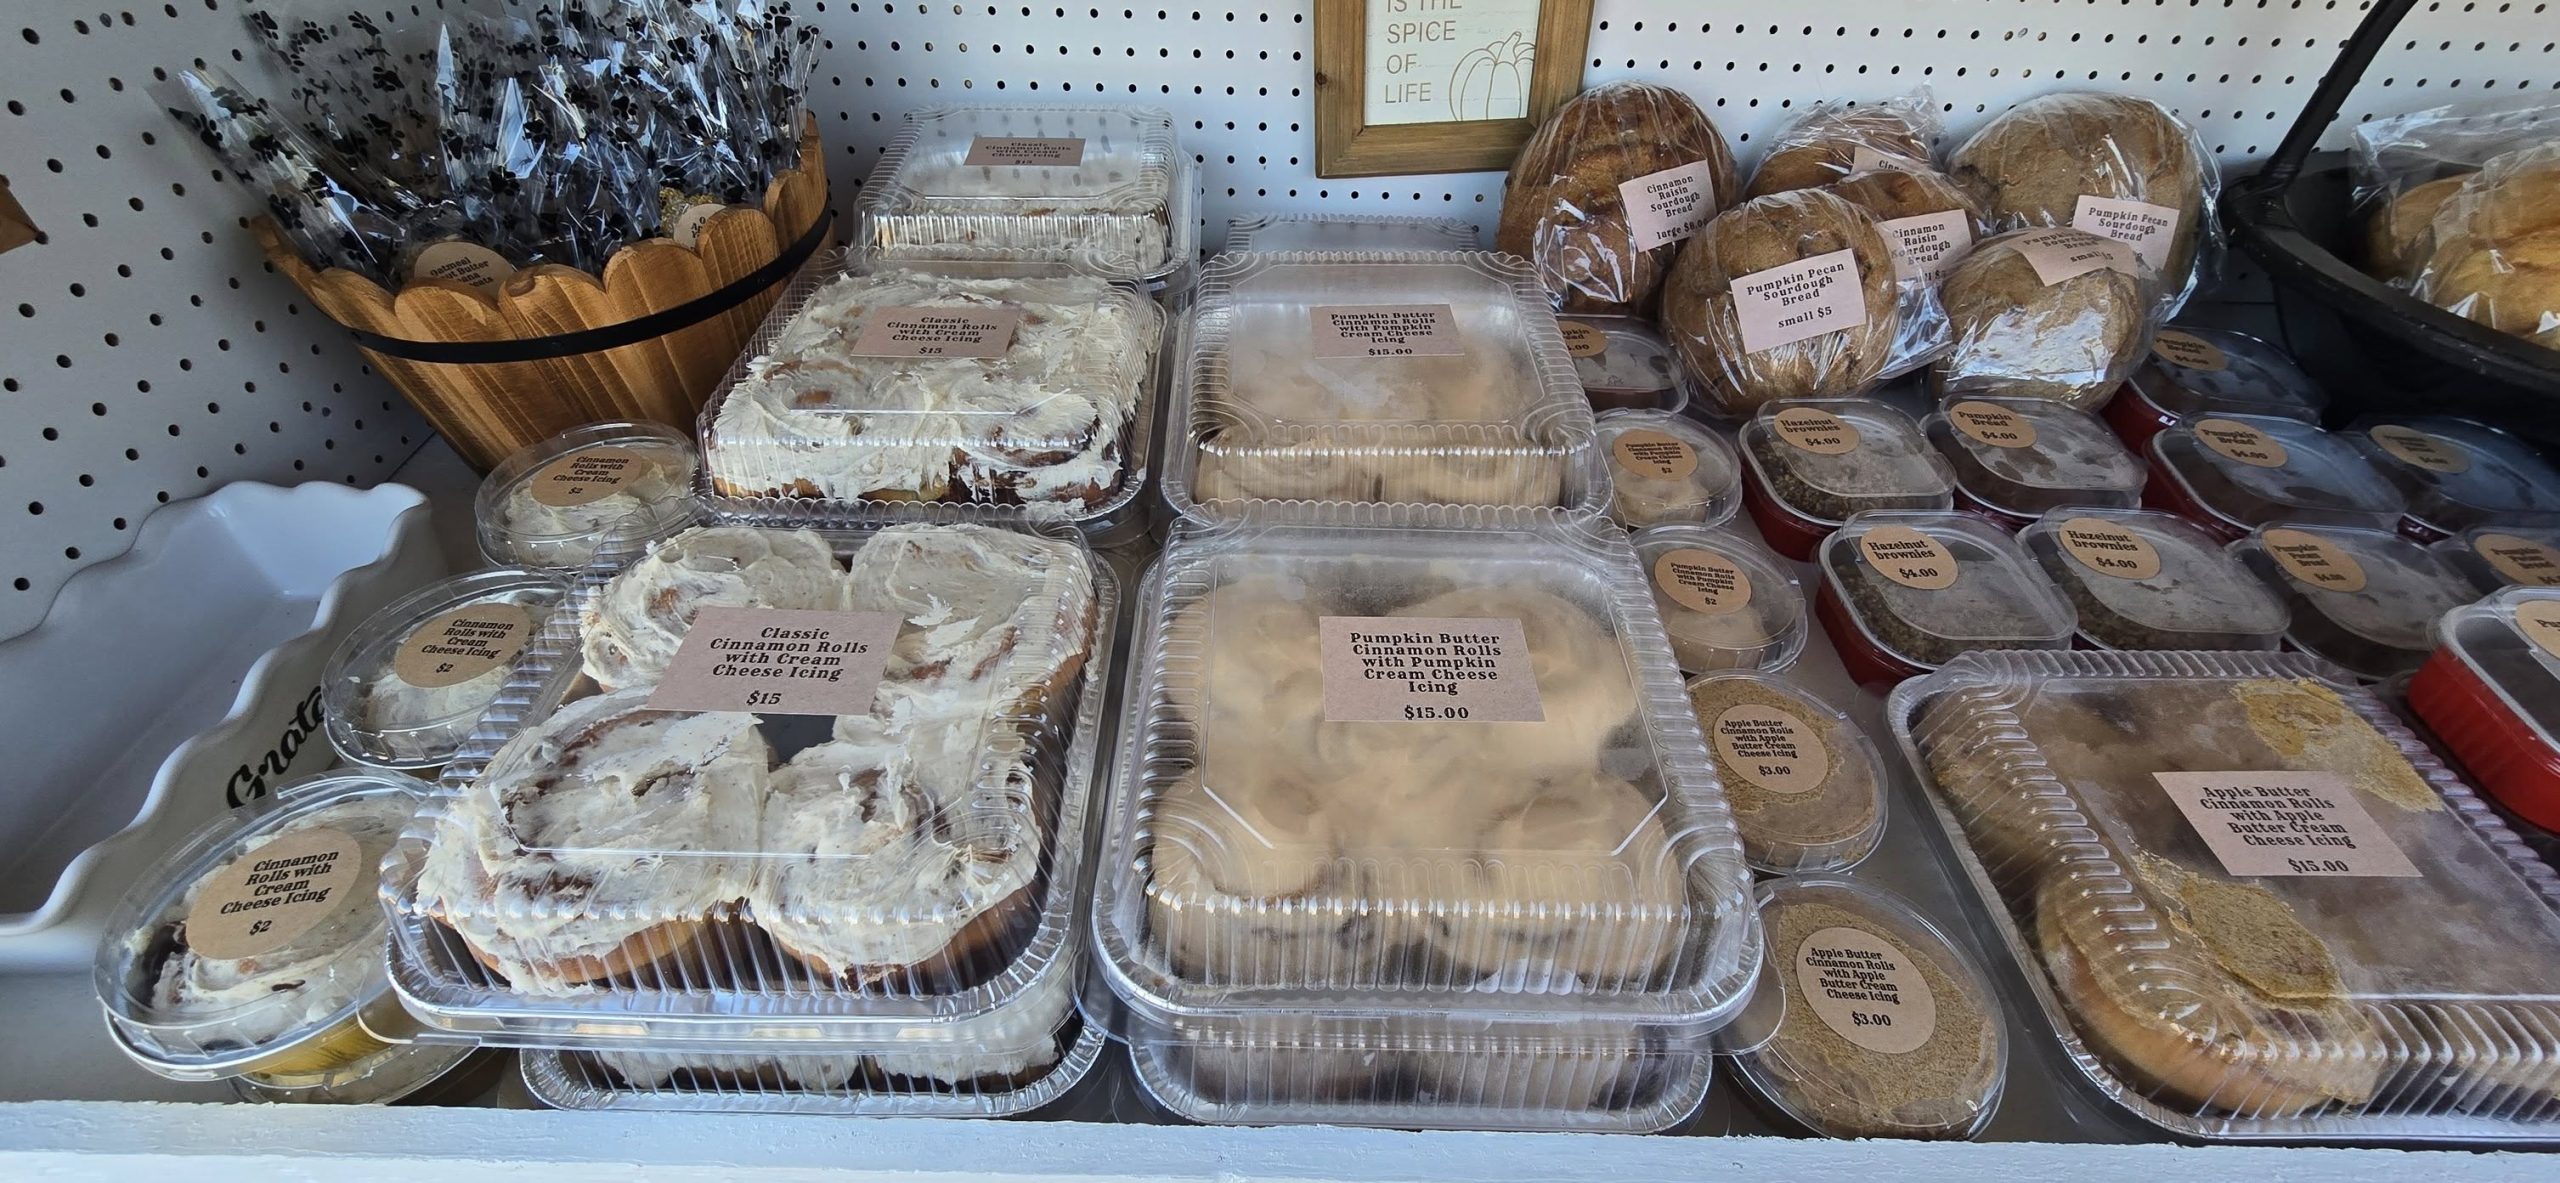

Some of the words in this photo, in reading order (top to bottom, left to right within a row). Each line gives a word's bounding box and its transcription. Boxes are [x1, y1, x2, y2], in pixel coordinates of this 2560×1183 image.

[1386, 20, 1457, 44] SPICE
[1386, 53, 1418, 74] OF
[1385, 82, 1432, 104] LIFE
[1647, 175, 1694, 194] Cinnamon
[1658, 186, 1689, 200] Raisin
[1650, 192, 1701, 212] Sourdough
[1665, 203, 1693, 217] Bread
[2089, 207, 2138, 220] Pumpkin
[2141, 214, 2168, 226] Pecan
[1656, 226, 1682, 240] large
[2099, 218, 2156, 235] Sourdough
[1904, 233, 1937, 247] Raisin
[2110, 229, 2143, 241] Bread
[430, 256, 472, 276] Oatmeal
[1746, 273, 1804, 296] Pumpkin
[1807, 263, 1845, 279] Pecan
[1763, 275, 1833, 301] Sourdough
[1781, 288, 1820, 307] Bread
[921, 316, 969, 324] Classic
[1330, 312, 1389, 321] Pumpkin
[1332, 319, 1400, 327] Cinnamon
[1778, 311, 1814, 328] small
[1817, 306, 1832, 318] $5
[886, 321, 957, 330] Cinnamon
[961, 323, 998, 331] Rolls
[898, 328, 930, 336] with
[1373, 324, 1432, 332] Pumpkin
[892, 334, 942, 342] Cheese
[945, 335, 983, 343] Icing
[918, 346, 942, 355] $15
[1368, 348, 1413, 356] $15.00
[1958, 411, 2013, 421] Pumpkin
[1780, 419, 1835, 427] Hazelnut
[1784, 425, 1841, 433] brownies
[1981, 430, 2018, 439] $4.00
[1805, 437, 1841, 446] $4.00
[576, 456, 629, 464] Cinnamon
[553, 474, 590, 482] Cheese
[591, 475, 621, 485] Icing
[2067, 530, 2132, 542] Hazelnut
[1867, 540, 1928, 551] Hazelnut
[2071, 539, 2138, 551] brownies
[1873, 549, 1936, 560] brownies
[1670, 562, 1706, 572] Pumpkin
[1708, 566, 1734, 574] Butter
[2096, 556, 2138, 569] $4.00
[1672, 568, 1713, 578] Cinnamon
[1899, 567, 1938, 579] $4.00
[1678, 579, 1705, 588] Cream
[1706, 582, 1734, 591] Cheese
[1696, 576, 1734, 585] Pumpkin
[1697, 586, 1719, 595] Icing
[1704, 597, 1717, 605] $2
[452, 618, 514, 631] Cinnamon
[442, 627, 476, 637] Rolls
[479, 628, 506, 639] with
[760, 626, 830, 640] Classic
[1350, 632, 1433, 647] Pumpkin
[1439, 633, 1500, 645] Butter
[447, 637, 488, 647] Cream
[710, 638, 810, 652] Cinnamon
[816, 641, 868, 654] Rolls
[421, 644, 464, 655] Cheese
[464, 647, 502, 659] Icing
[1352, 644, 1448, 656] Cinnamon
[1453, 644, 1502, 656] Rolls
[725, 651, 770, 664] with
[776, 652, 841, 666] Cream
[1361, 656, 1405, 668] with
[1411, 656, 1496, 671] Pumpkin
[435, 662, 454, 673] $2
[712, 664, 784, 678] Cheese
[789, 666, 844, 683] Icing
[1363, 668, 1426, 680] Cream
[1431, 668, 1498, 680] Cheese
[1408, 680, 1459, 696] Icing
[746, 690, 782, 706] $15
[1404, 704, 1470, 720] $15.00
[1720, 727, 1769, 735] Cinnamon
[1770, 727, 1794, 735] Rolls
[1724, 720, 1752, 729] Apple
[1758, 735, 1786, 743] Apple
[1731, 742, 1762, 750] Butter
[1764, 742, 1796, 750] Cream
[1737, 750, 1772, 758] Cheese
[1773, 750, 1798, 759] Icing
[1758, 765, 1791, 776] $3.00
[2202, 786, 2252, 800] Apple
[2253, 786, 2312, 798] Butter
[2200, 798, 2287, 810] Cinnamon
[2291, 797, 2335, 809] Rolls
[2230, 810, 2272, 821] with
[2275, 810, 2325, 823] Apple
[2227, 822, 2286, 834] Butter
[2289, 821, 2348, 834] Cream
[2242, 834, 2305, 846] Cheese
[2306, 834, 2357, 850] Icing
[253, 851, 339, 873] Cinnamon
[2288, 858, 2349, 874] $15.00
[244, 869, 289, 886] Rolls
[293, 862, 332, 878] with
[254, 879, 310, 897] Cream
[220, 895, 282, 915] Cheese
[284, 887, 332, 905] Icing
[249, 920, 273, 936] $2
[1810, 947, 1844, 959] Apple
[1844, 949, 1883, 960] Butter
[1805, 956, 1865, 970] Cinnamon
[1866, 959, 1896, 971] Rolls
[1823, 968, 1850, 979] with
[1852, 969, 1886, 982] Apple
[1819, 977, 1858, 990] Butter
[1859, 979, 1898, 992] Cream
[1826, 988, 1868, 1001] Cheese
[1869, 990, 1901, 1005] Icing
[1851, 1011, 1892, 1027] $3.00
